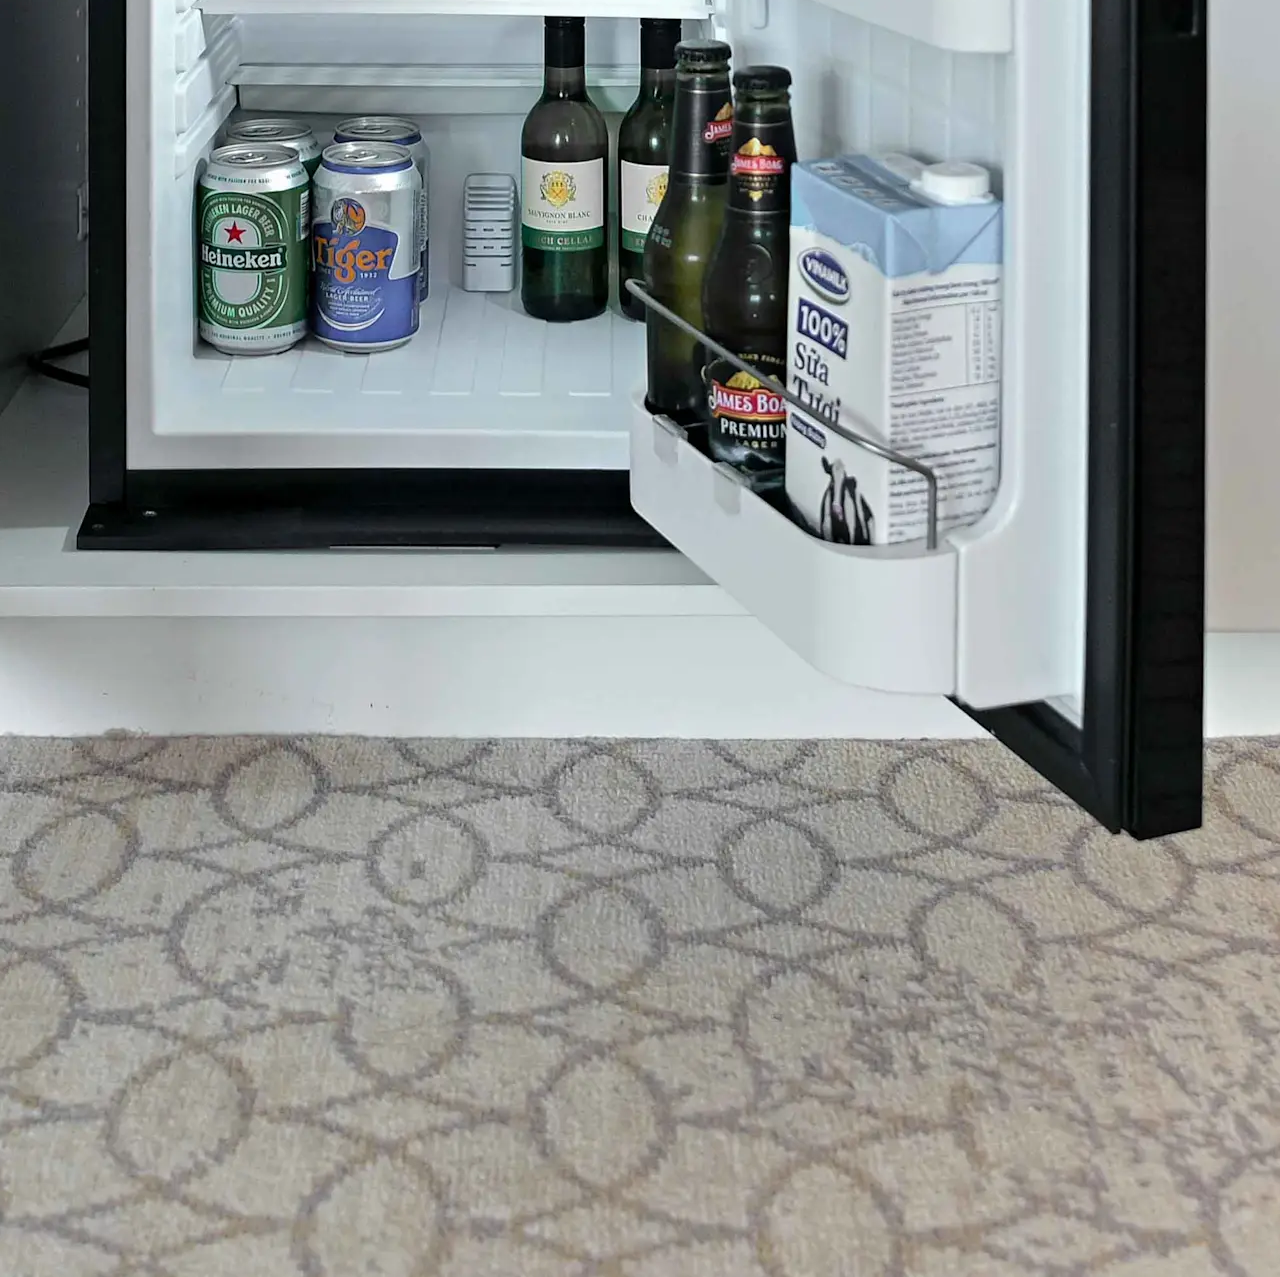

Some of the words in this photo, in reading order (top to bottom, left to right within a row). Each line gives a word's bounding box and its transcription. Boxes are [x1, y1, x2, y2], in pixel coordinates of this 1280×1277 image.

[231, 203, 261, 221] LAGER
[258, 214, 275, 238] BEER
[528, 208, 566, 220] SAUVIGNON
[569, 210, 591, 219] BLANC
[201, 244, 283, 269] Heineken
[315, 236, 393, 284] Tiger
[806, 256, 848, 292] VINAMILK
[206, 283, 235, 318] PREMIUM
[238, 286, 275, 318] QUALITY
[801, 305, 846, 353] 100%
[795, 342, 829, 387] Sữa
[708, 385, 753, 413] JAMES
[756, 393, 787, 414] BOA
